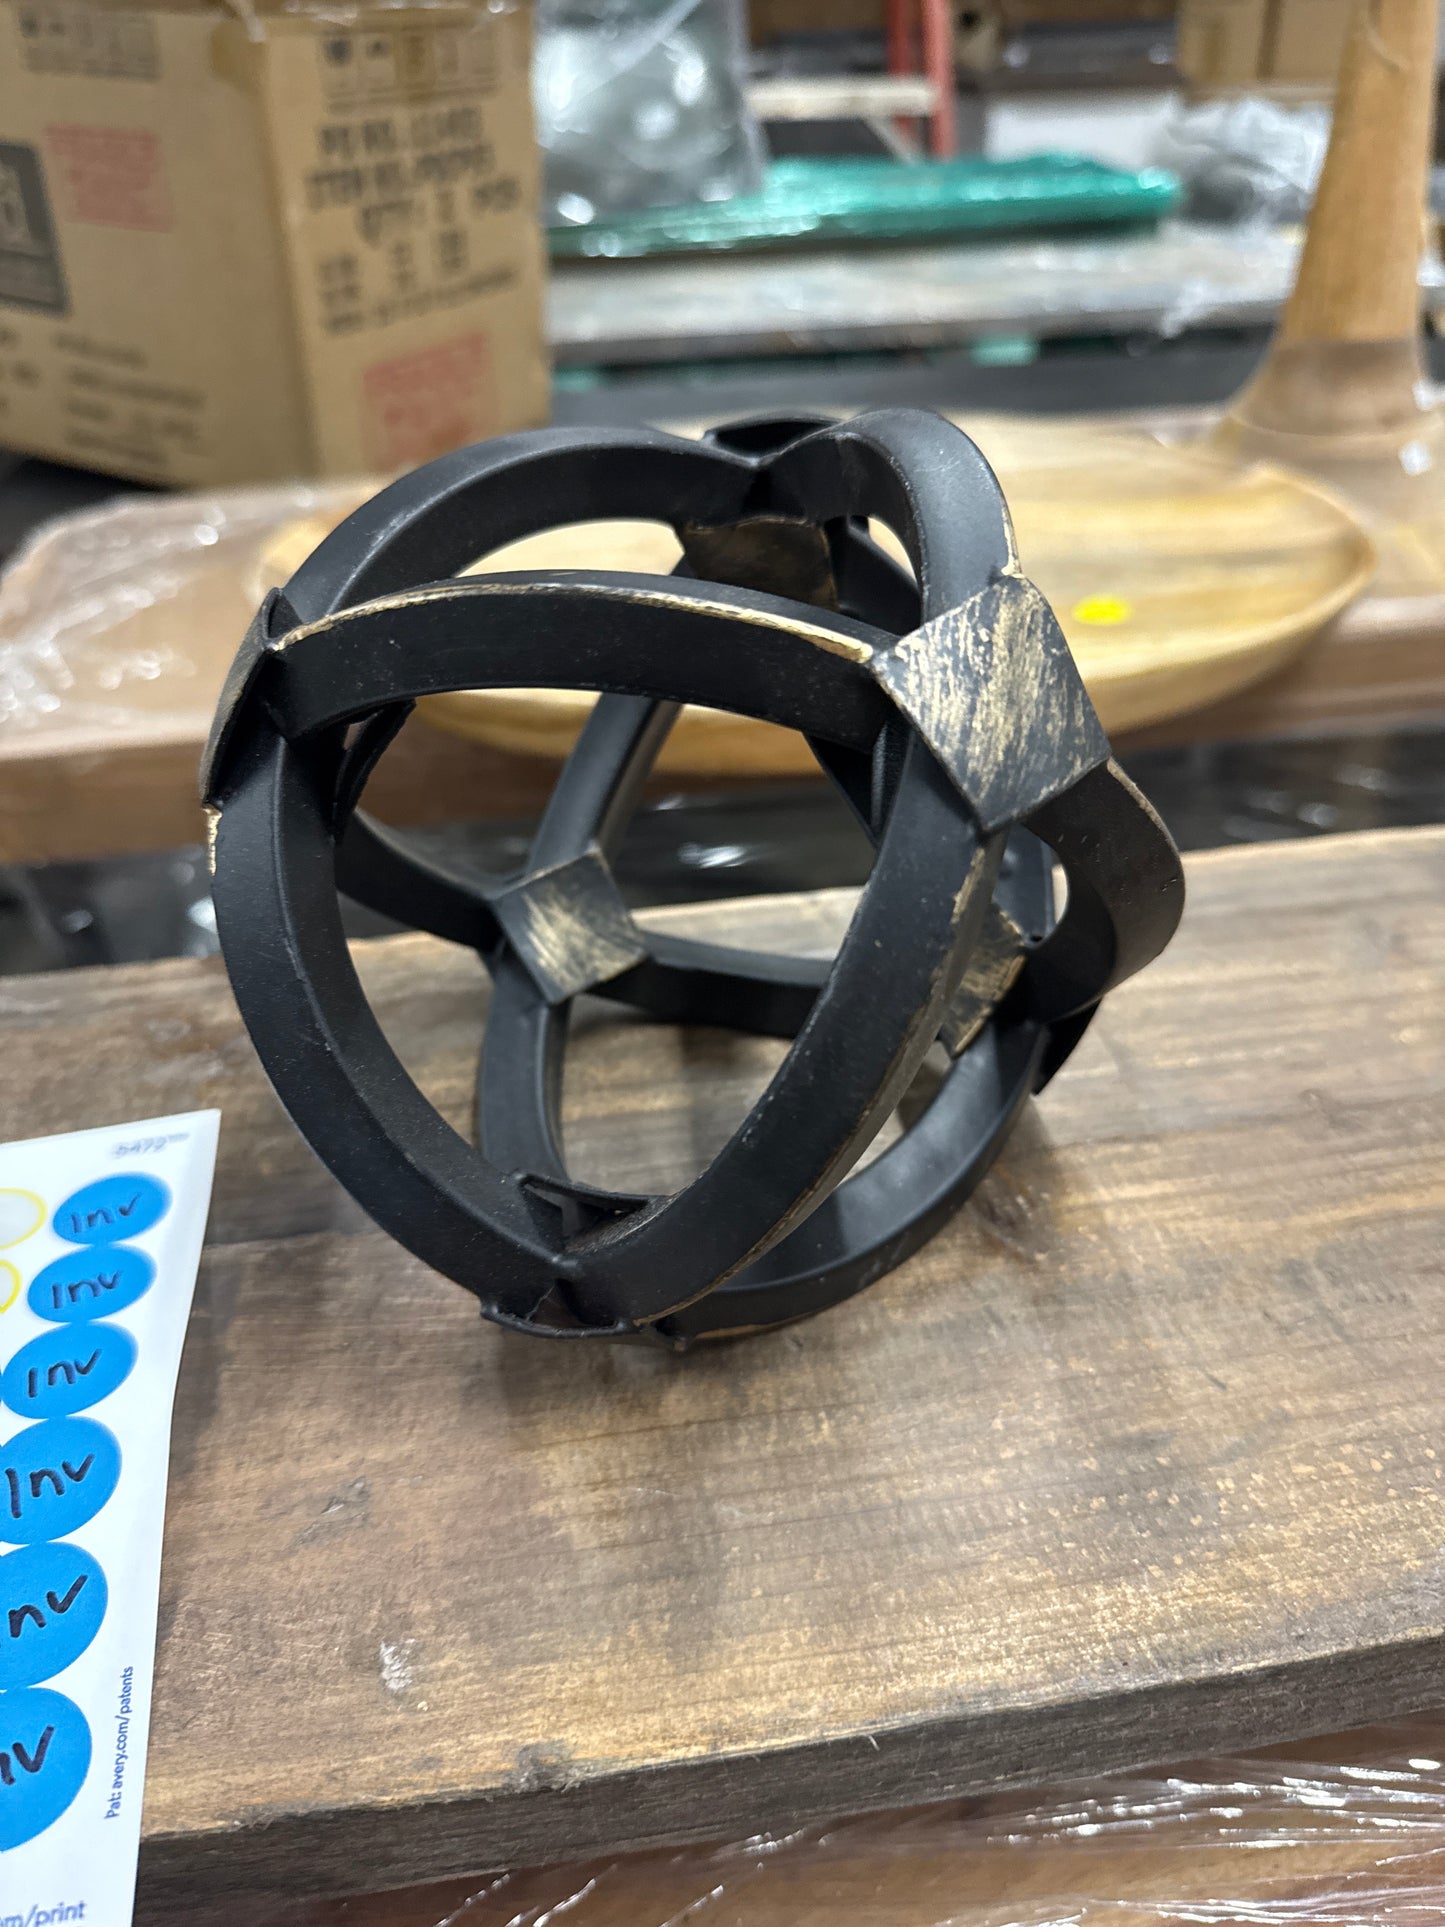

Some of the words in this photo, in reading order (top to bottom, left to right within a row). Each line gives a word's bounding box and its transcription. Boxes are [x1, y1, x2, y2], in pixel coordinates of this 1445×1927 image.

[70, 1191, 142, 1233] Inv
[52, 1269, 124, 1310] Inv
[27, 1347, 103, 1398] Inv
[5, 1453, 95, 1518] Inv
[4, 1574, 89, 1642] nv
[112, 1665, 134, 1790] avery.com/patents
